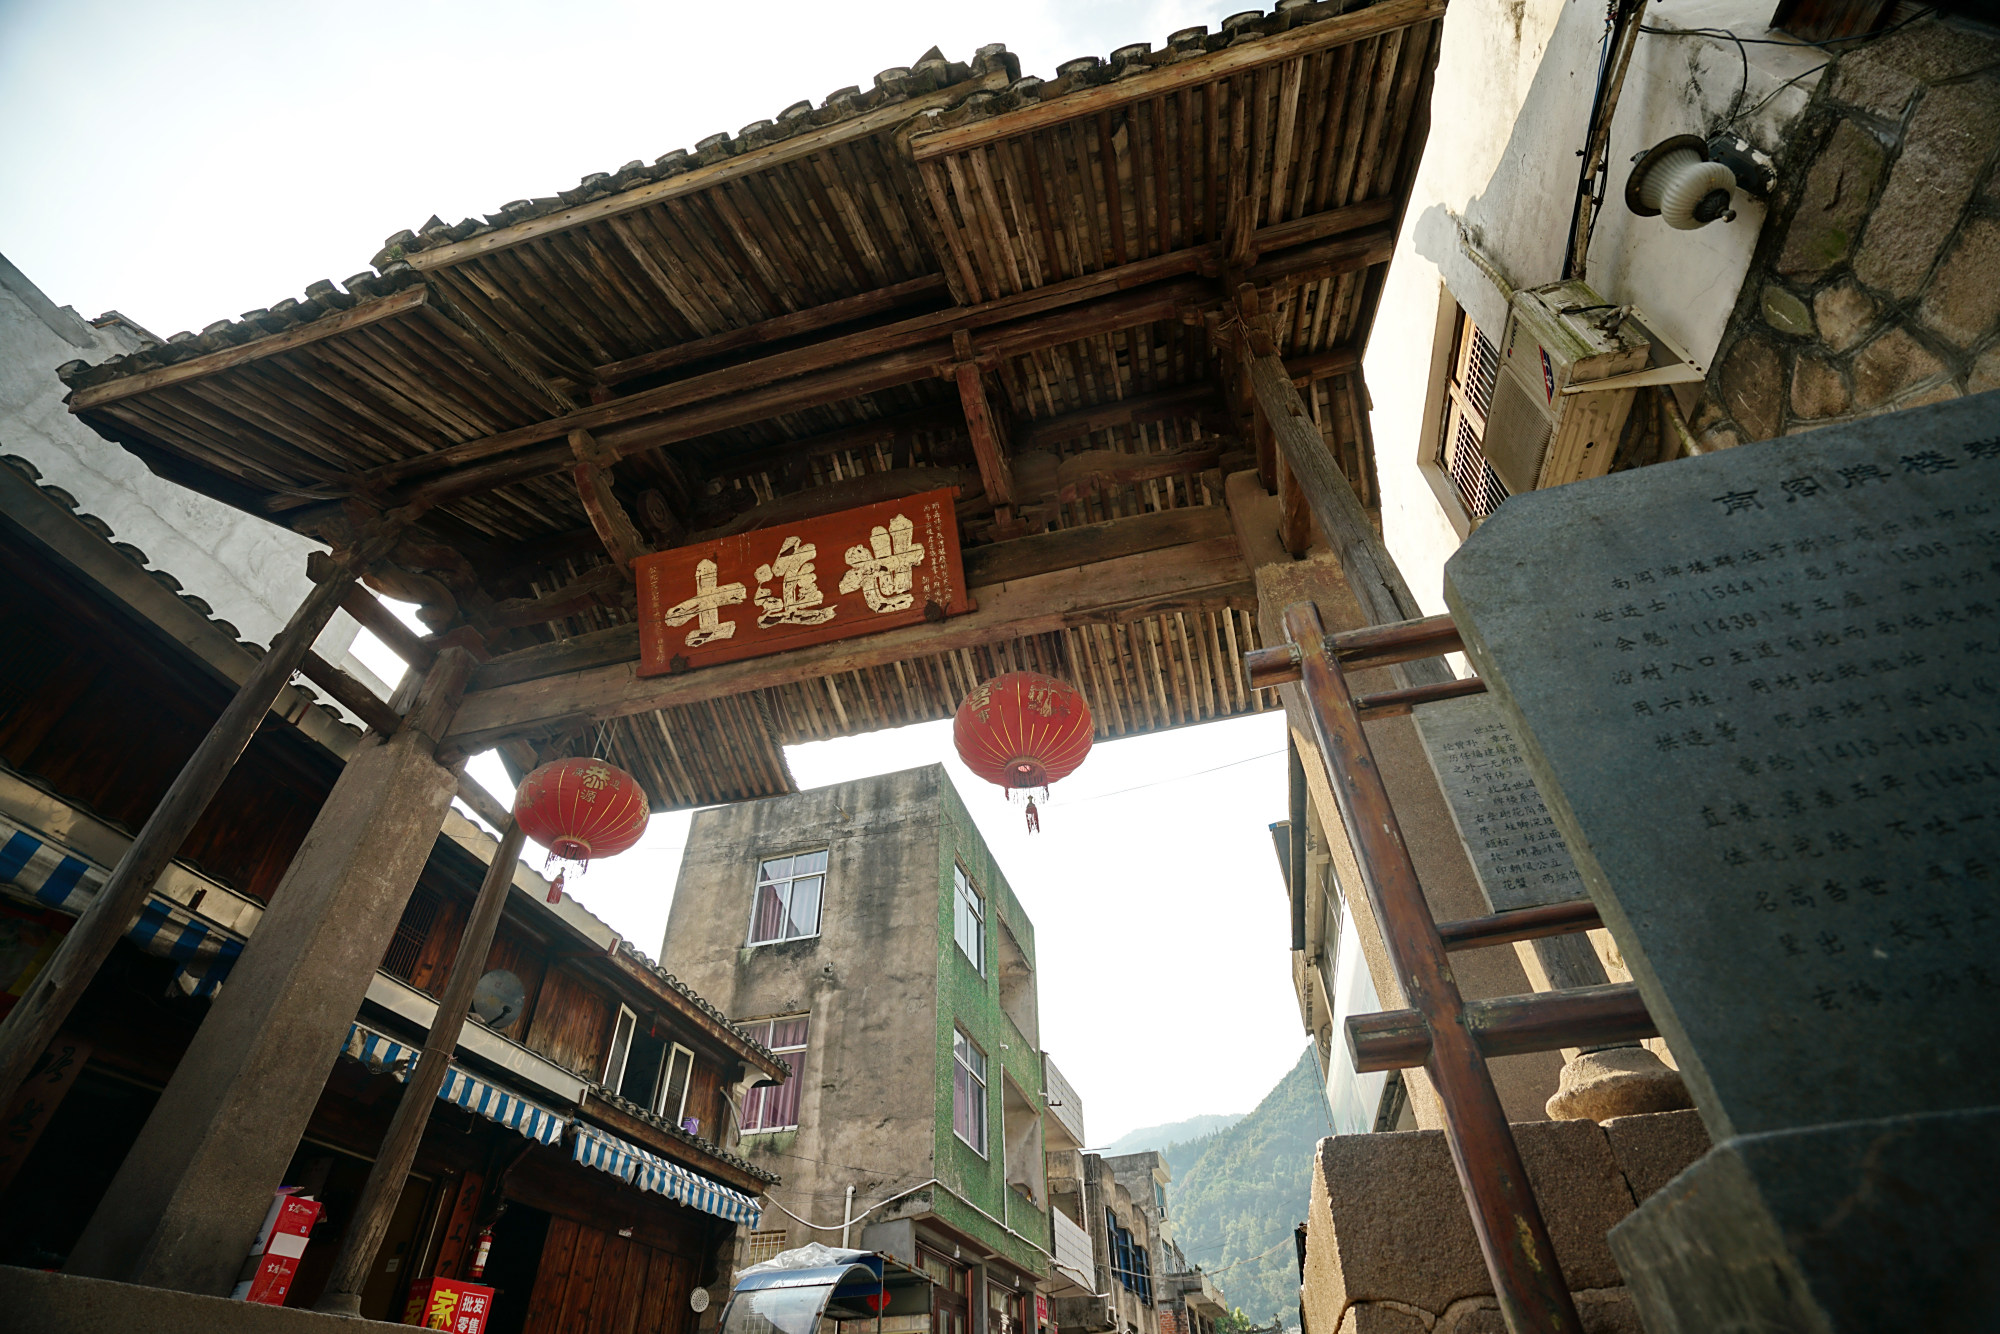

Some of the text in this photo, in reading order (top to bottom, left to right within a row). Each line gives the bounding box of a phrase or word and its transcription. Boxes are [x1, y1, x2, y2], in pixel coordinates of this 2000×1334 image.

[1712, 436, 2000, 517] 南阁牌楼群
[582, 766, 611, 791] 恭
[580, 790, 598, 804] 源
[430, 1289, 459, 1328] 家
[461, 1295, 486, 1314] 批发
[457, 1316, 481, 1334] 零售
